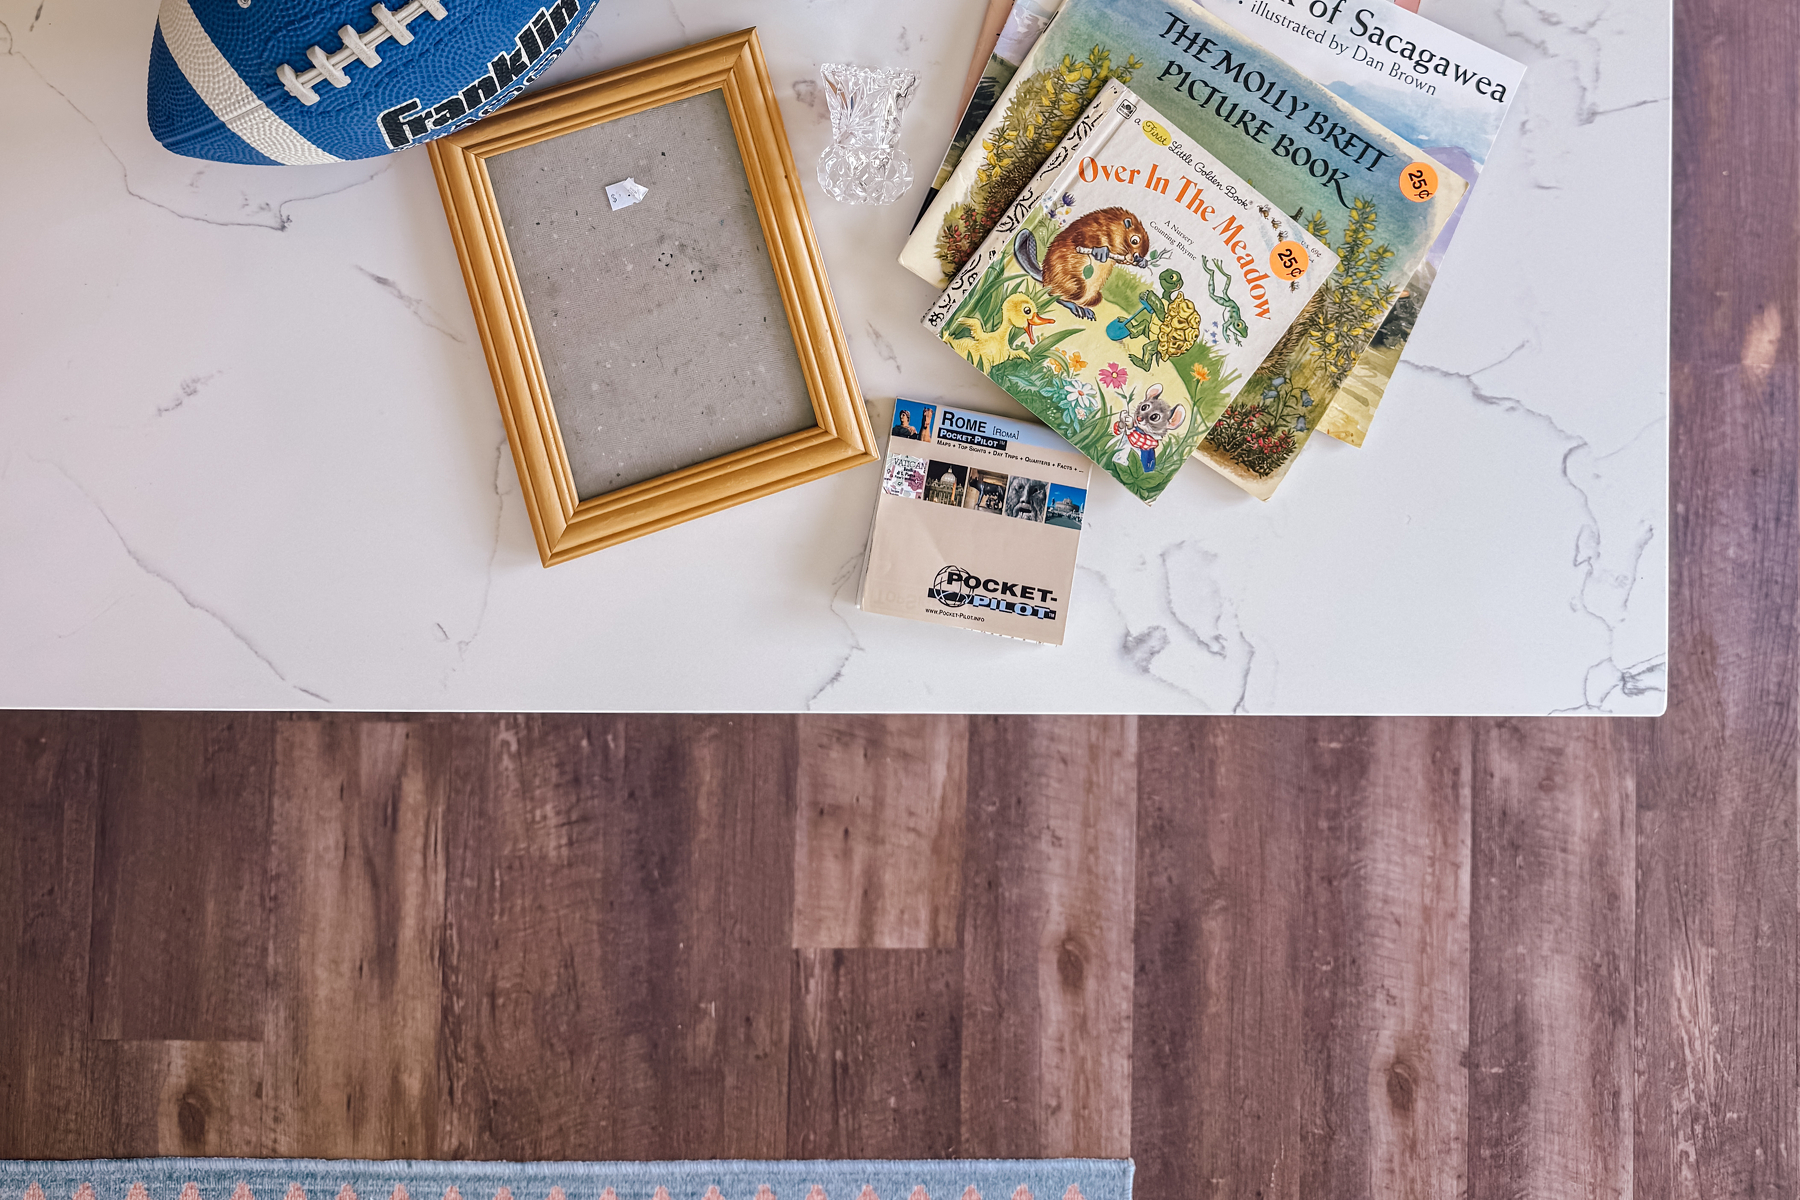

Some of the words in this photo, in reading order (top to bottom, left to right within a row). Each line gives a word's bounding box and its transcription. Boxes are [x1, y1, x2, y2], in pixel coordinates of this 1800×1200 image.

[1250, 0, 1327, 44] illustrated
[1328, 34, 1350, 56] by
[1351, 45, 1385, 72] Dan
[1388, 61, 1438, 96] Brown
[1349, 8, 1508, 103] Sacagawea
[1159, 11, 1218, 63] THE
[1210, 49, 1310, 120] MOLLY
[1303, 111, 1395, 173] BRETT
[1133, 117, 1142, 126] a
[1142, 120, 1168, 147] First
[1168, 140, 1193, 167] Little
[1194, 161, 1224, 191] Golden
[1156, 60, 1274, 145] PICTURE
[1270, 133, 1351, 210] BOOK
[1407, 169, 1431, 200] 25¢
[1078, 156, 1141, 185] Over
[1144, 163, 1170, 195] In
[1174, 174, 1216, 222] The
[1212, 214, 1273, 321] Meadow
[1149, 220, 1176, 246] Counting
[1176, 237, 1197, 261] Rhyme
[1170, 222, 1195, 246] Nursery
[1278, 248, 1305, 278] 25¢
[946, 571, 1058, 603] POCKET-
